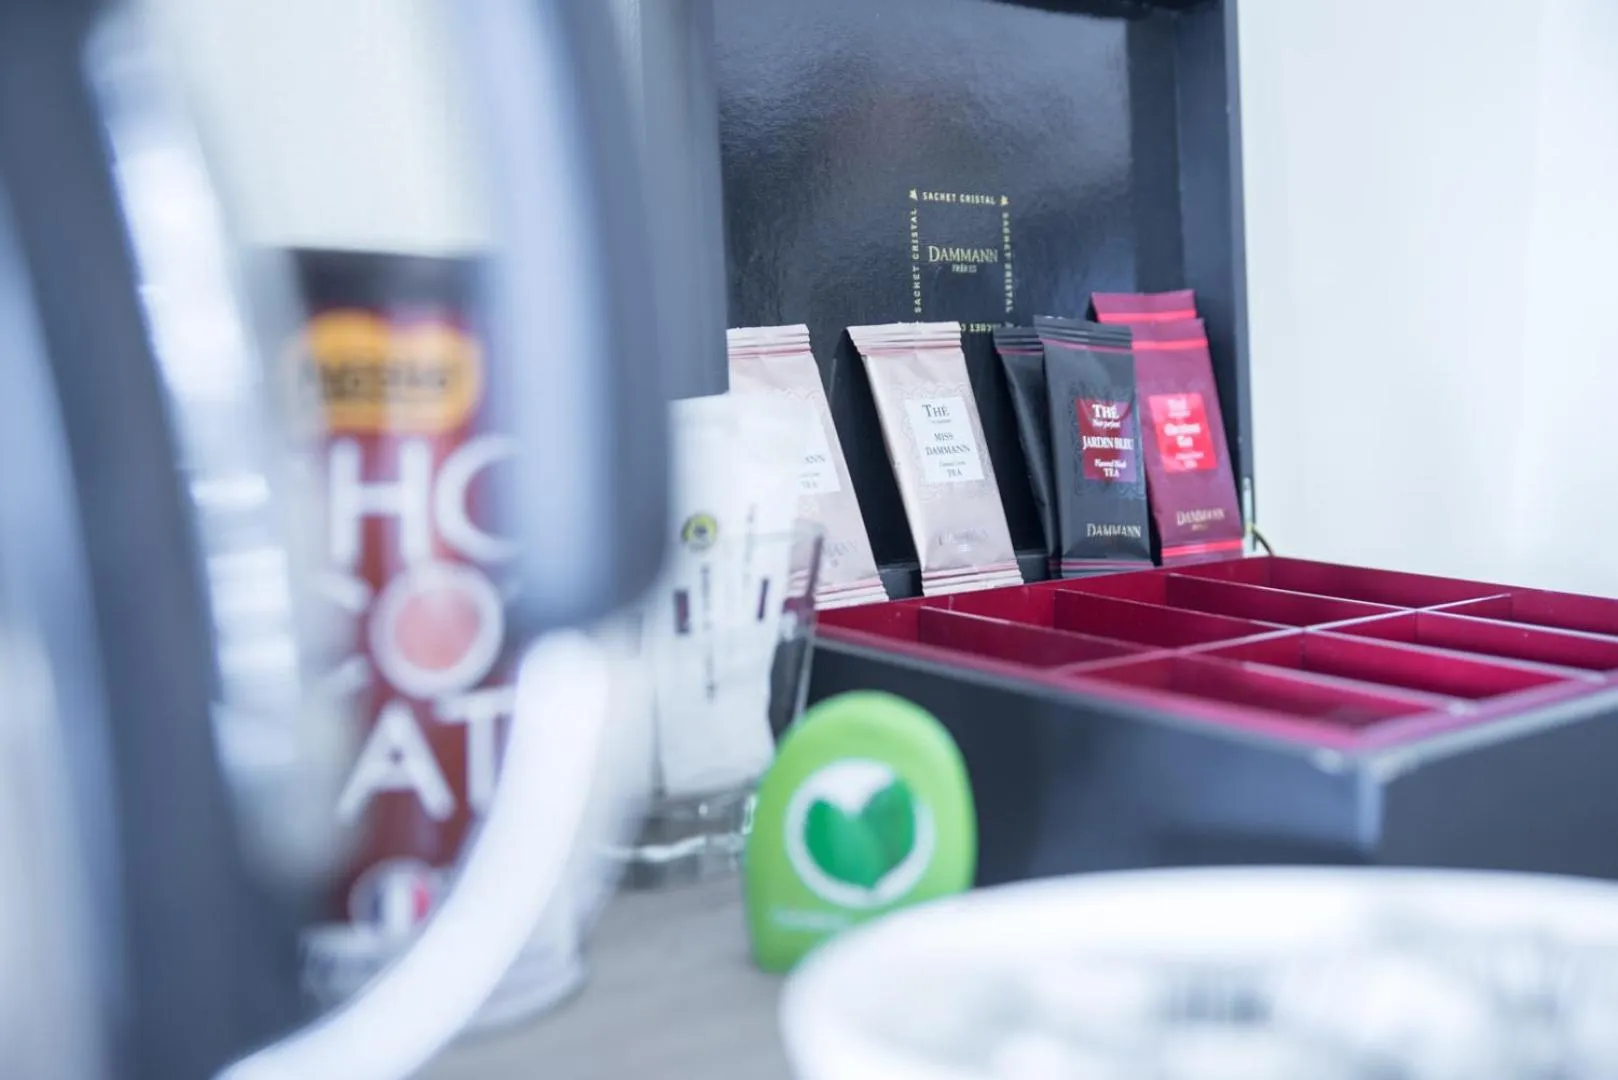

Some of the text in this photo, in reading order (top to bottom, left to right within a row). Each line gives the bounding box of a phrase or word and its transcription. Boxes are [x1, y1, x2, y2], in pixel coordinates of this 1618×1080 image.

[922, 191, 996, 206] SACHET CRISTAL
[910, 207, 922, 313] SACHET CRISTAL
[928, 245, 998, 263] DAMMANN
[925, 444, 970, 456] DAMMANN
[1082, 435, 1114, 450] JARDIN
[1086, 523, 1142, 538] DAMMANN
